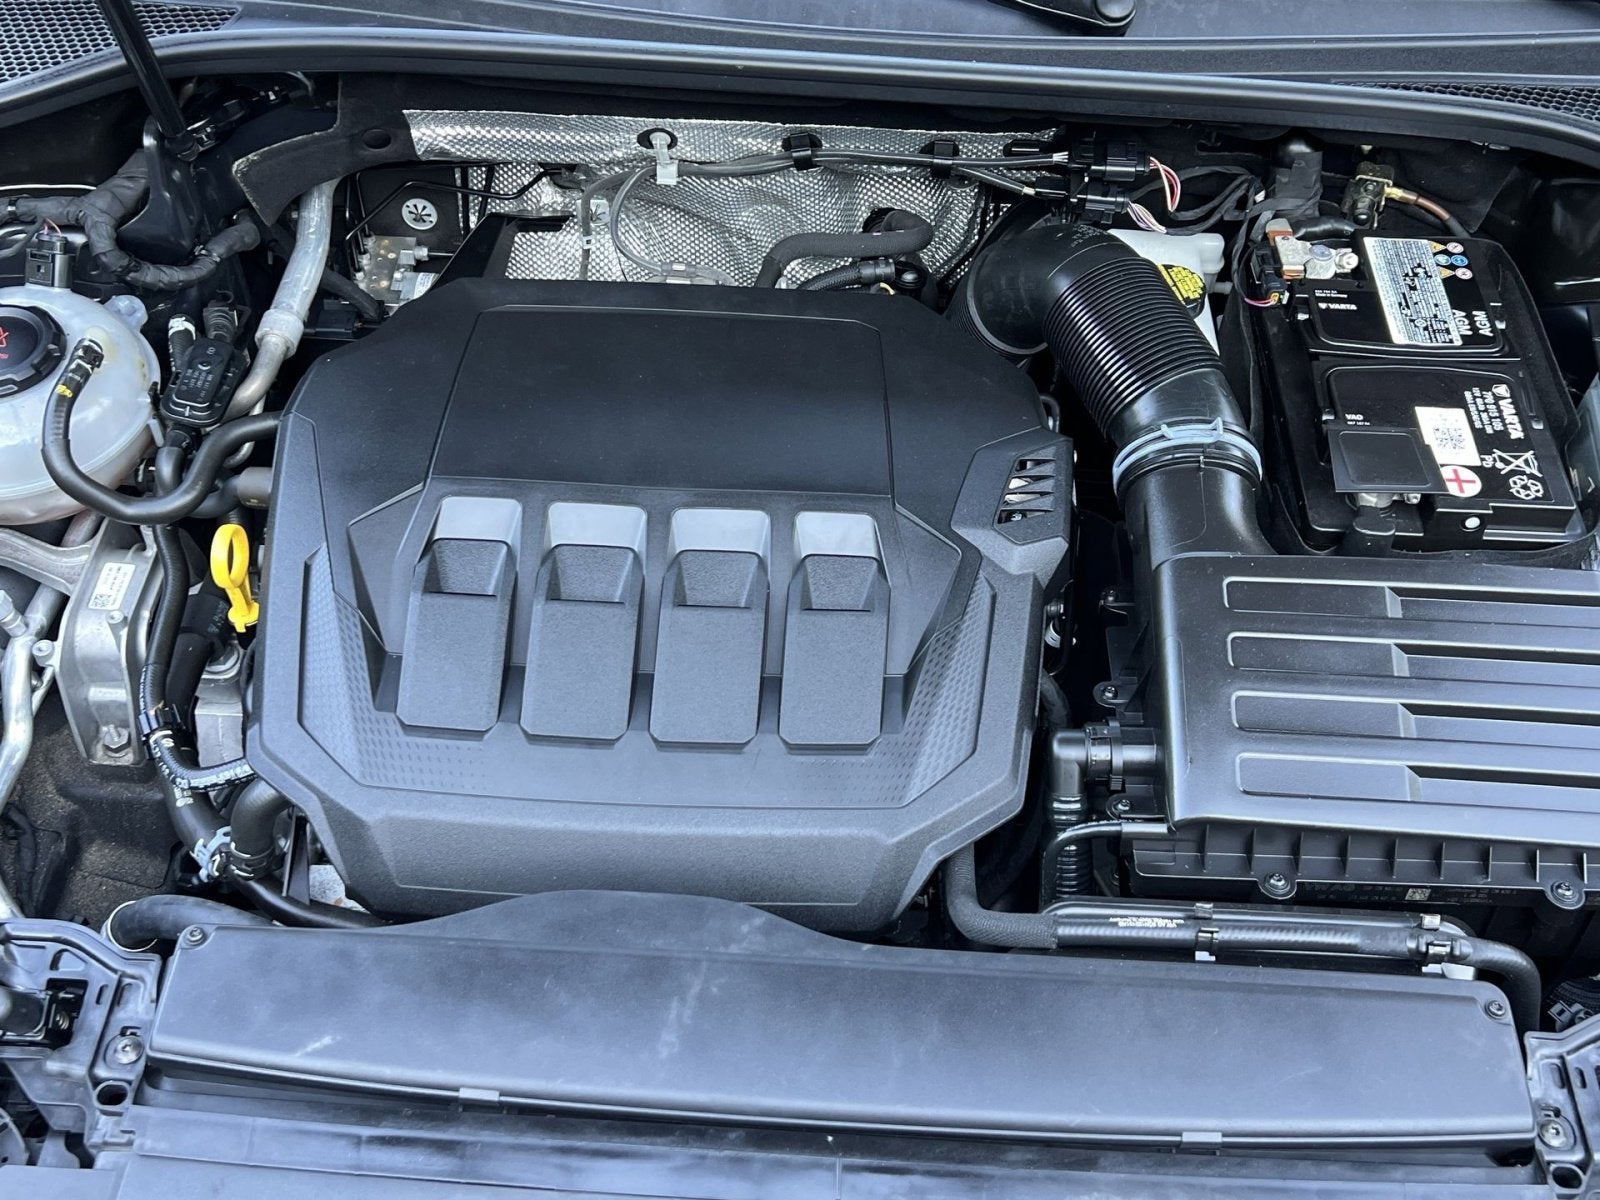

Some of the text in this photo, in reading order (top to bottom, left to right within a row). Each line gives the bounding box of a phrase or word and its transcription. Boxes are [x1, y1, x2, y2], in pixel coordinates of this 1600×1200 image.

[1452, 309, 1473, 335] AGM
[1472, 310, 1494, 336] AGM
[1498, 398, 1525, 440] VARTA
[1480, 455, 1495, 468] Pb
